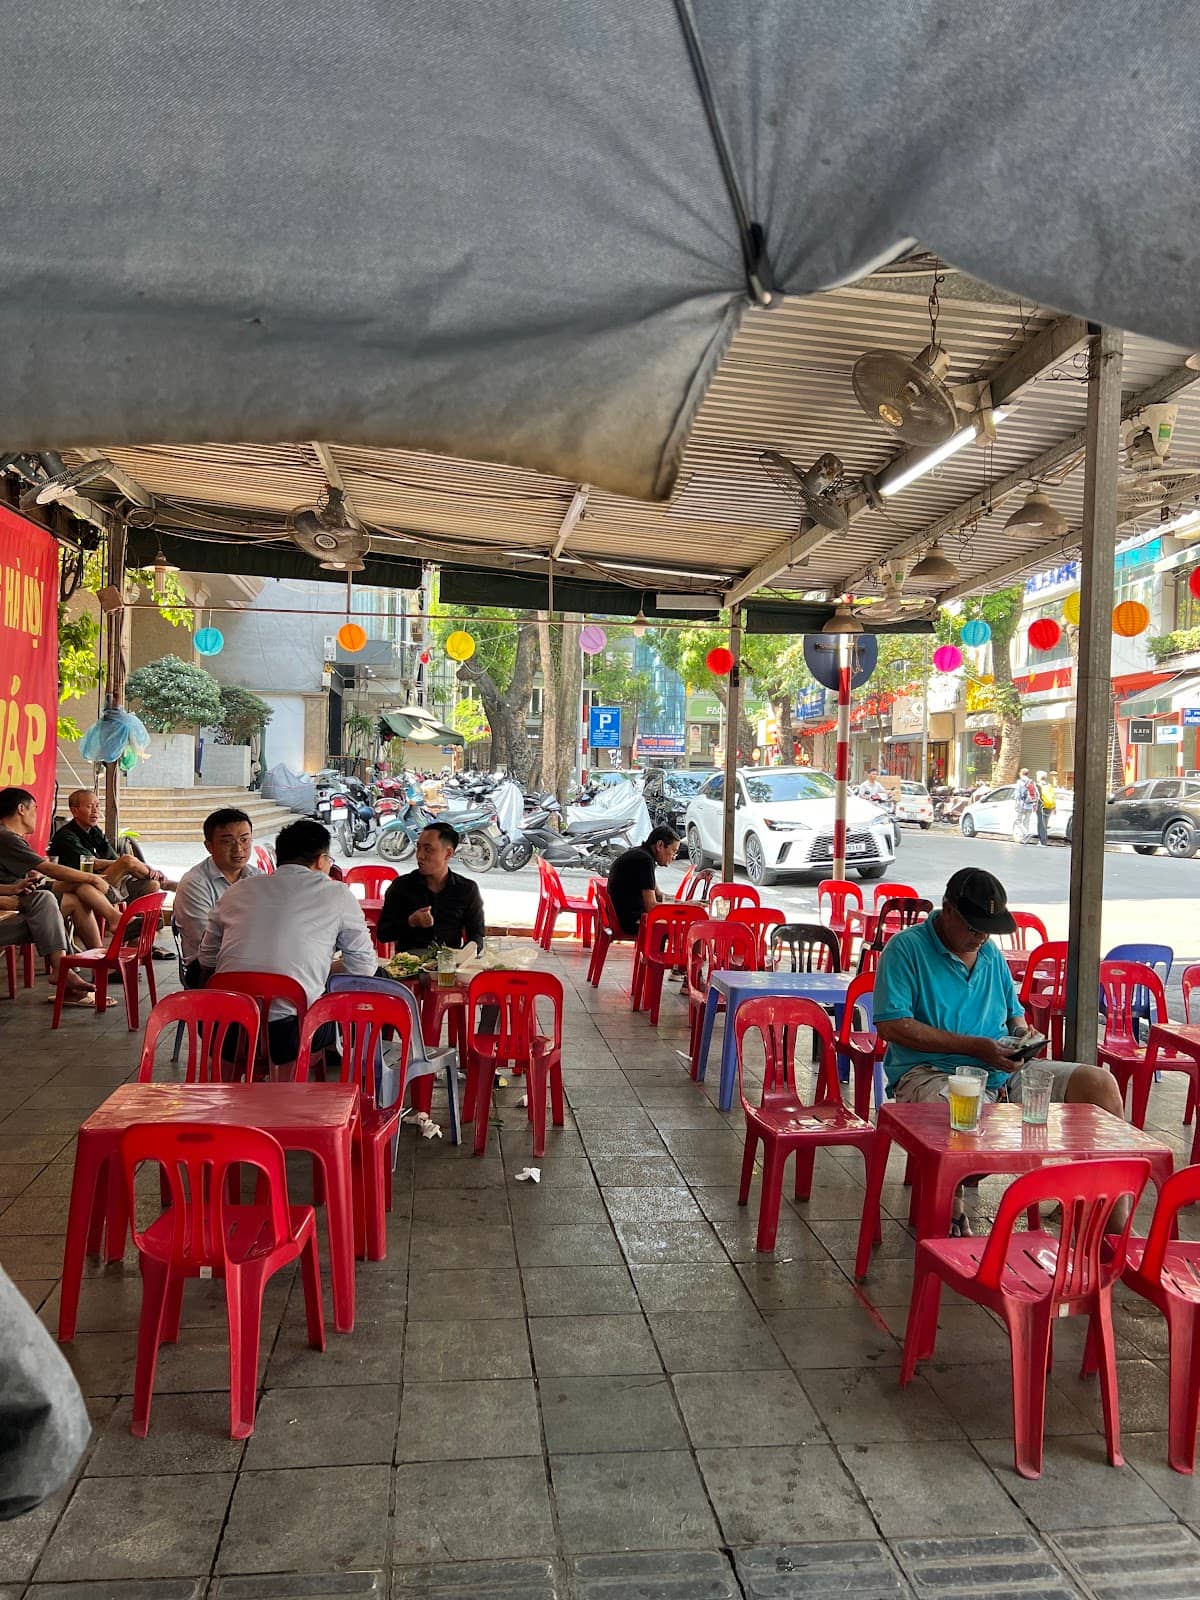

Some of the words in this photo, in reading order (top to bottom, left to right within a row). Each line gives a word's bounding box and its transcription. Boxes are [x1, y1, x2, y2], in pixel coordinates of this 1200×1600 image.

[4, 557, 21, 630] HÀ
[0, 674, 47, 786] ÁP
[599, 713, 612, 730] P
